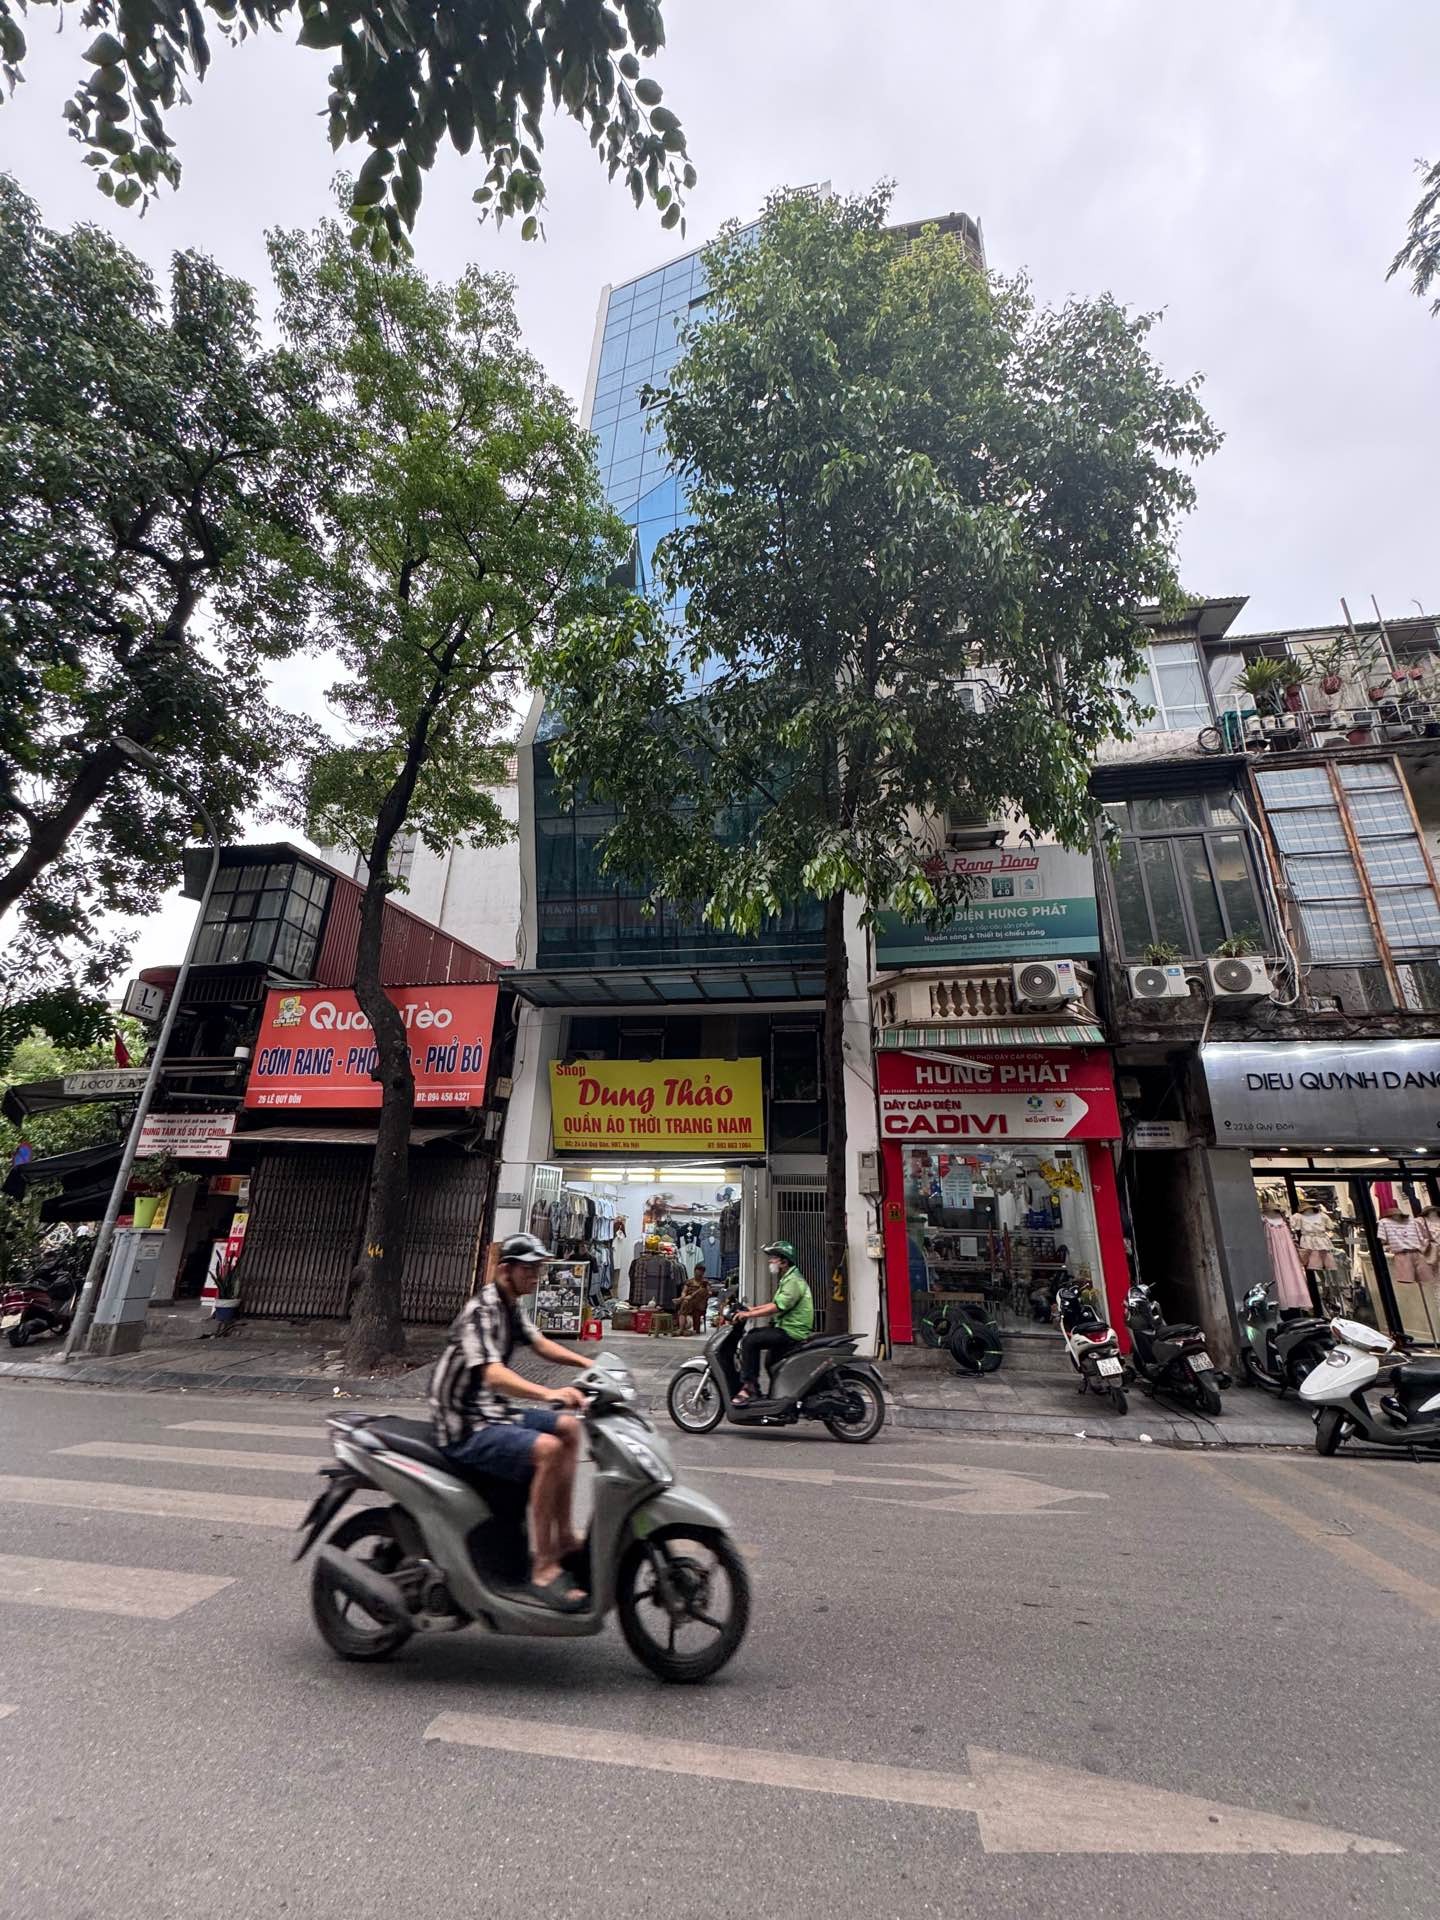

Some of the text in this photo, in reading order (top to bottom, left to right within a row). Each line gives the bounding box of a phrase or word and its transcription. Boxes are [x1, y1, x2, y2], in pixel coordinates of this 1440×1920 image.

[955, 910, 984, 924] ĐIỆN
[988, 907, 1028, 921] HƯNG
[1032, 904, 1068, 917] PHÁT
[1027, 928, 1045, 937] sáng
[257, 1045, 292, 1076] CƠM
[292, 1047, 334, 1076] RANG
[424, 1035, 460, 1075] PHỞ
[460, 1037, 484, 1074] BÒ
[556, 1064, 586, 1078] Shop
[1000, 1059, 1071, 1084] PHÁT
[1247, 1071, 1440, 1091] DIEU QUYNH DAN
[578, 1074, 734, 1115] Dung Thảo
[883, 1098, 962, 1112] DÂY CÁP ĐIỆN
[563, 1112, 752, 1134] QUẦN ÁO THỜI TRANG NAM
[884, 1114, 1009, 1135] CADIVI
[511, 1193, 521, 1202] 24
